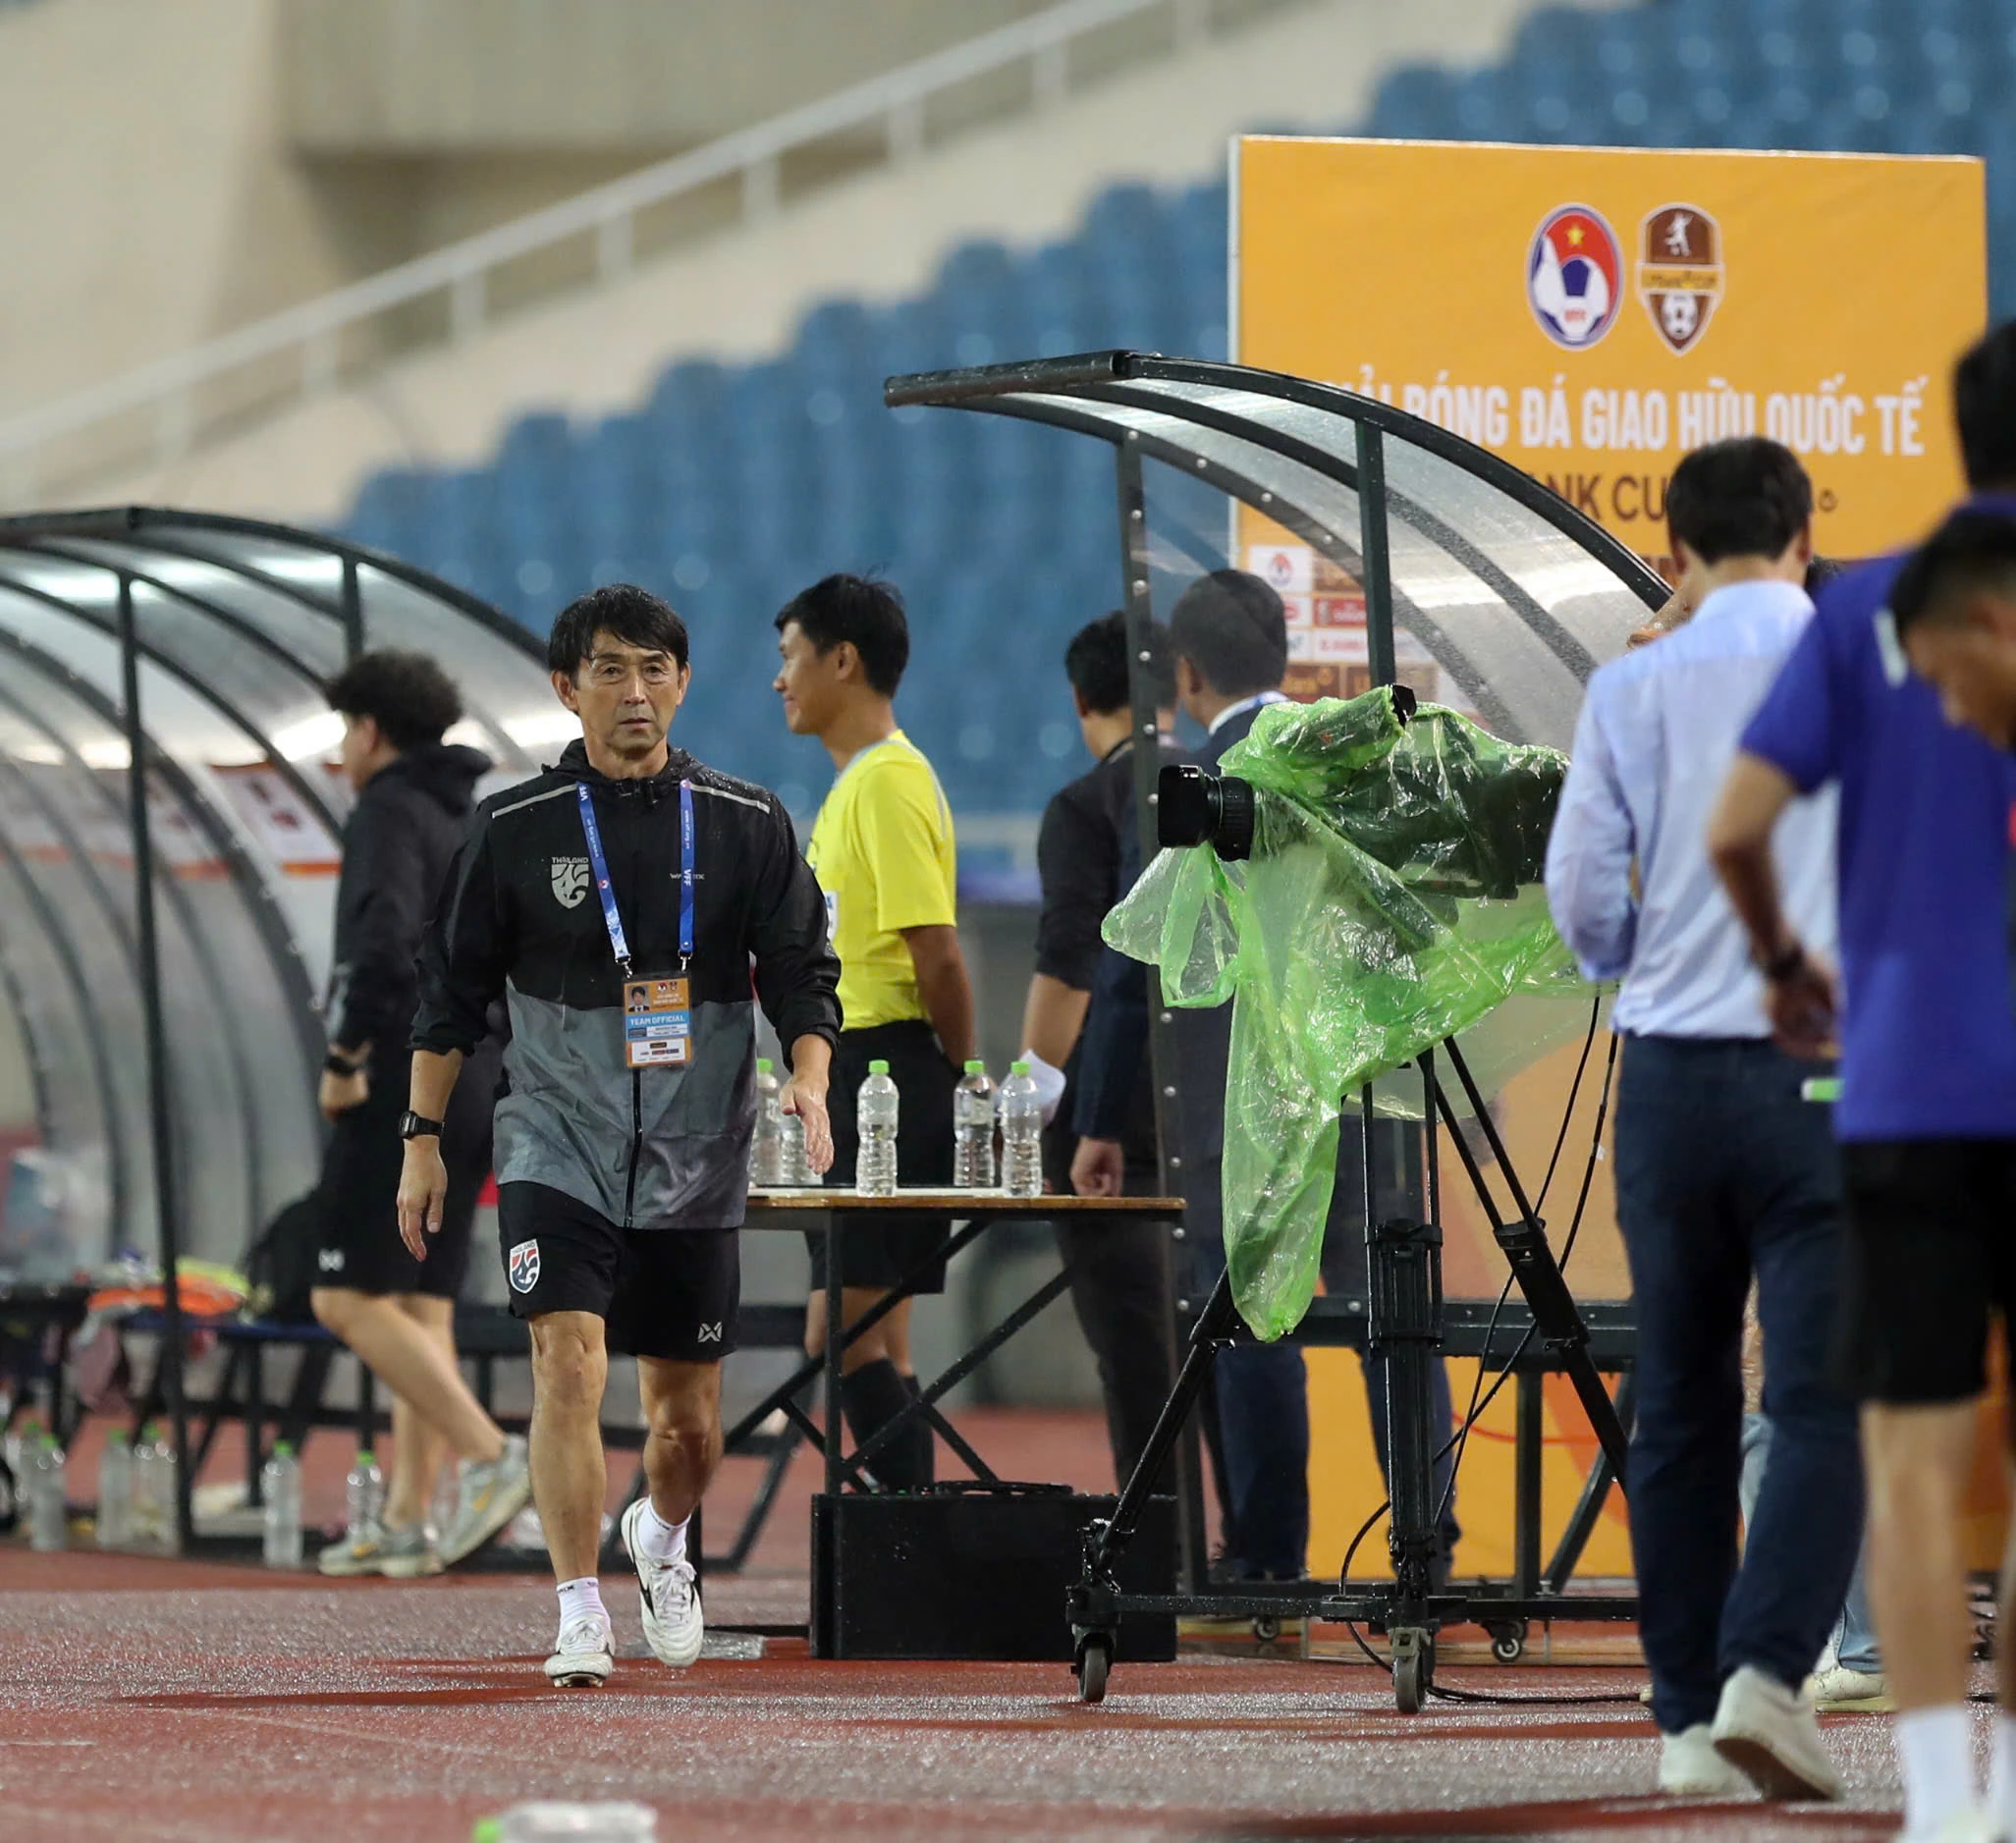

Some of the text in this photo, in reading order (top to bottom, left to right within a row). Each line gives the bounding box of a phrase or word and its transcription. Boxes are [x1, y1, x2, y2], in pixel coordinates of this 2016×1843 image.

[1520, 373, 1571, 449] ĐÁ
[1582, 388, 1667, 450] GIAO
[1767, 372, 1865, 455] QUỐC
[1874, 375, 1930, 456] TẾ
[1611, 475, 1668, 521] CU
[629, 1014, 684, 1026] TEAM OFFICIAL
